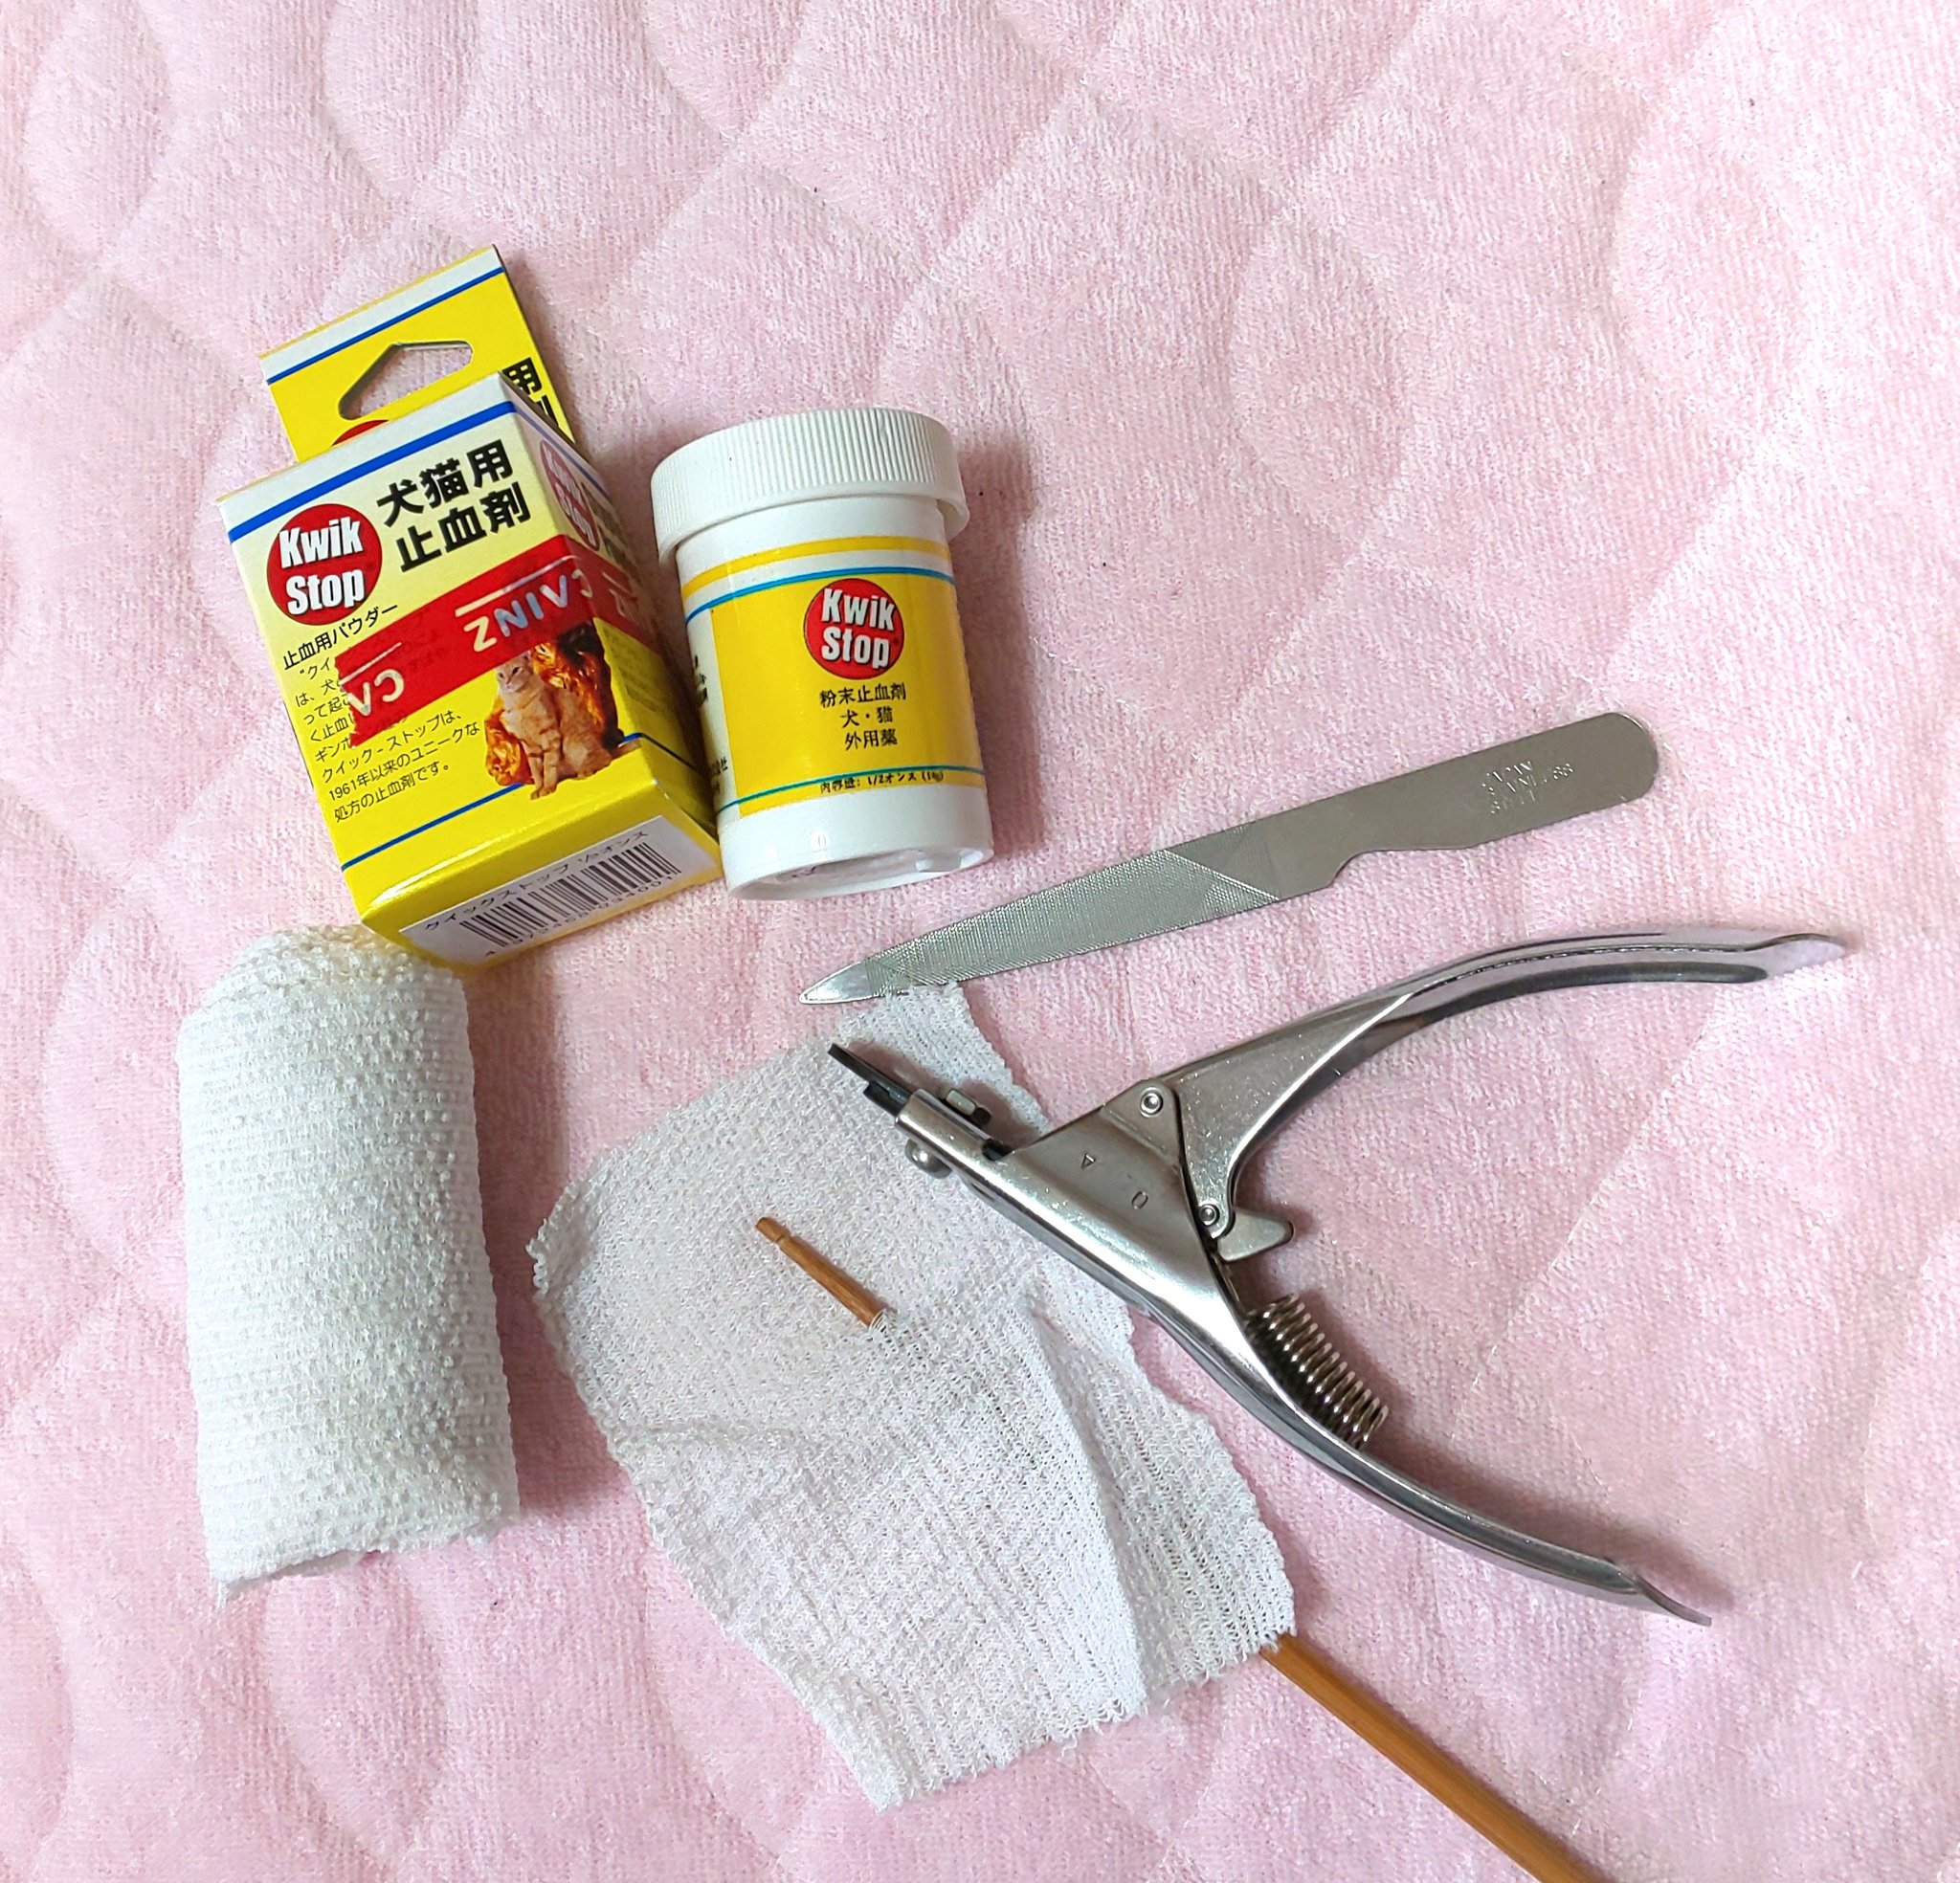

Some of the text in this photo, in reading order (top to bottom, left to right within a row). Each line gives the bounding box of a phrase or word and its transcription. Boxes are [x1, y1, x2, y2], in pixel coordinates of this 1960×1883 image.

[376, 439, 513, 527] 犬猫用
[278, 517, 364, 569] Kwik
[395, 481, 531, 572] 止血剤
[286, 568, 365, 615] Stop
[821, 587, 895, 631] Kwik
[283, 605, 398, 671] 止血用パウダー
[821, 626, 890, 670] Stop
[819, 682, 906, 708] 粉末止血剤
[841, 706, 894, 728] 犬・猫
[329, 721, 480, 801] 1961年以来のユニークな
[845, 728, 898, 751] 外用薬
[335, 761, 449, 823] 処方の止血剤です。
